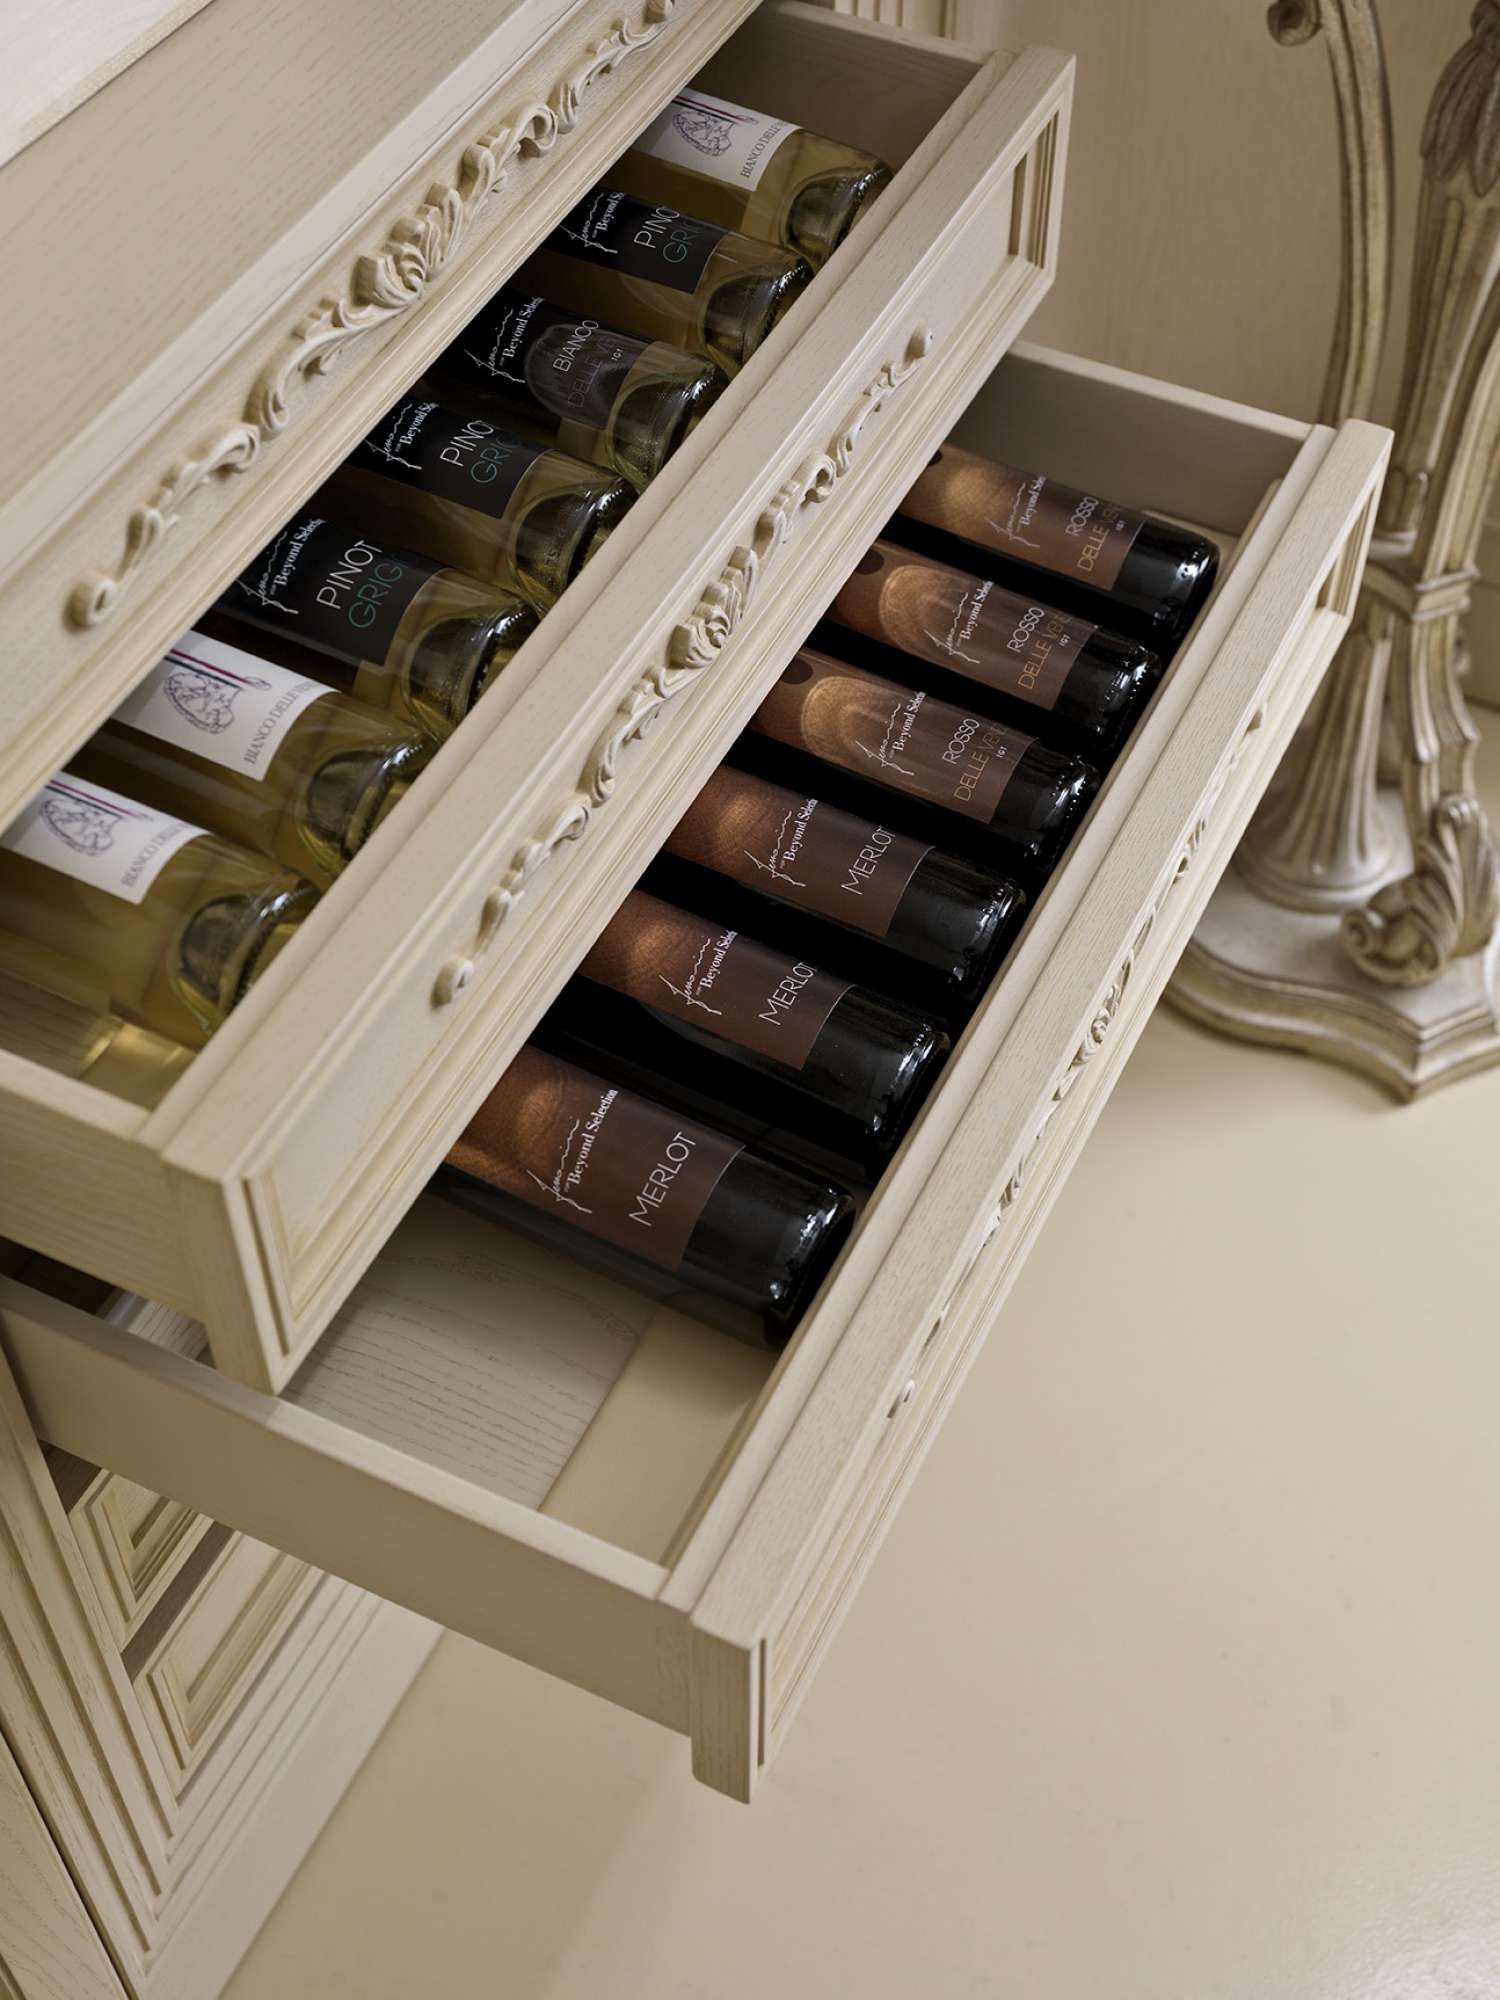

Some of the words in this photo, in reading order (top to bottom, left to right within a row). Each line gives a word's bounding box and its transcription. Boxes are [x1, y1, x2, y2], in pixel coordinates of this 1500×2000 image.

[595, 197, 619, 231] Beyond
[633, 207, 680, 249] PINO
[503, 318, 529, 358] Beyond
[553, 320, 599, 372] BIANCO
[567, 355, 603, 408] DELLE
[400, 411, 427, 445] Beyond
[1065, 496, 1099, 536] ROSSO
[274, 540, 303, 586] Beyond
[1076, 524, 1110, 572] DELLE
[316, 540, 383, 610] PINOT
[960, 601, 983, 640] Beyond
[1007, 607, 1045, 653] ROSSO
[1018, 639, 1053, 690] DELLE
[243, 718, 278, 764] BIANCO
[892, 711, 916, 752] Beyond
[942, 718, 980, 765] ROSSO
[953, 751, 990, 802] DELLE
[783, 820, 807, 862] Beyond
[840, 825, 896, 896] MERLOT
[700, 947, 725, 989] Beyond
[758, 961, 818, 1026] MERLOT
[567, 1132, 596, 1186] Beyond
[584, 1088, 619, 1133] Selection
[628, 1131, 697, 1227] MERLOT
